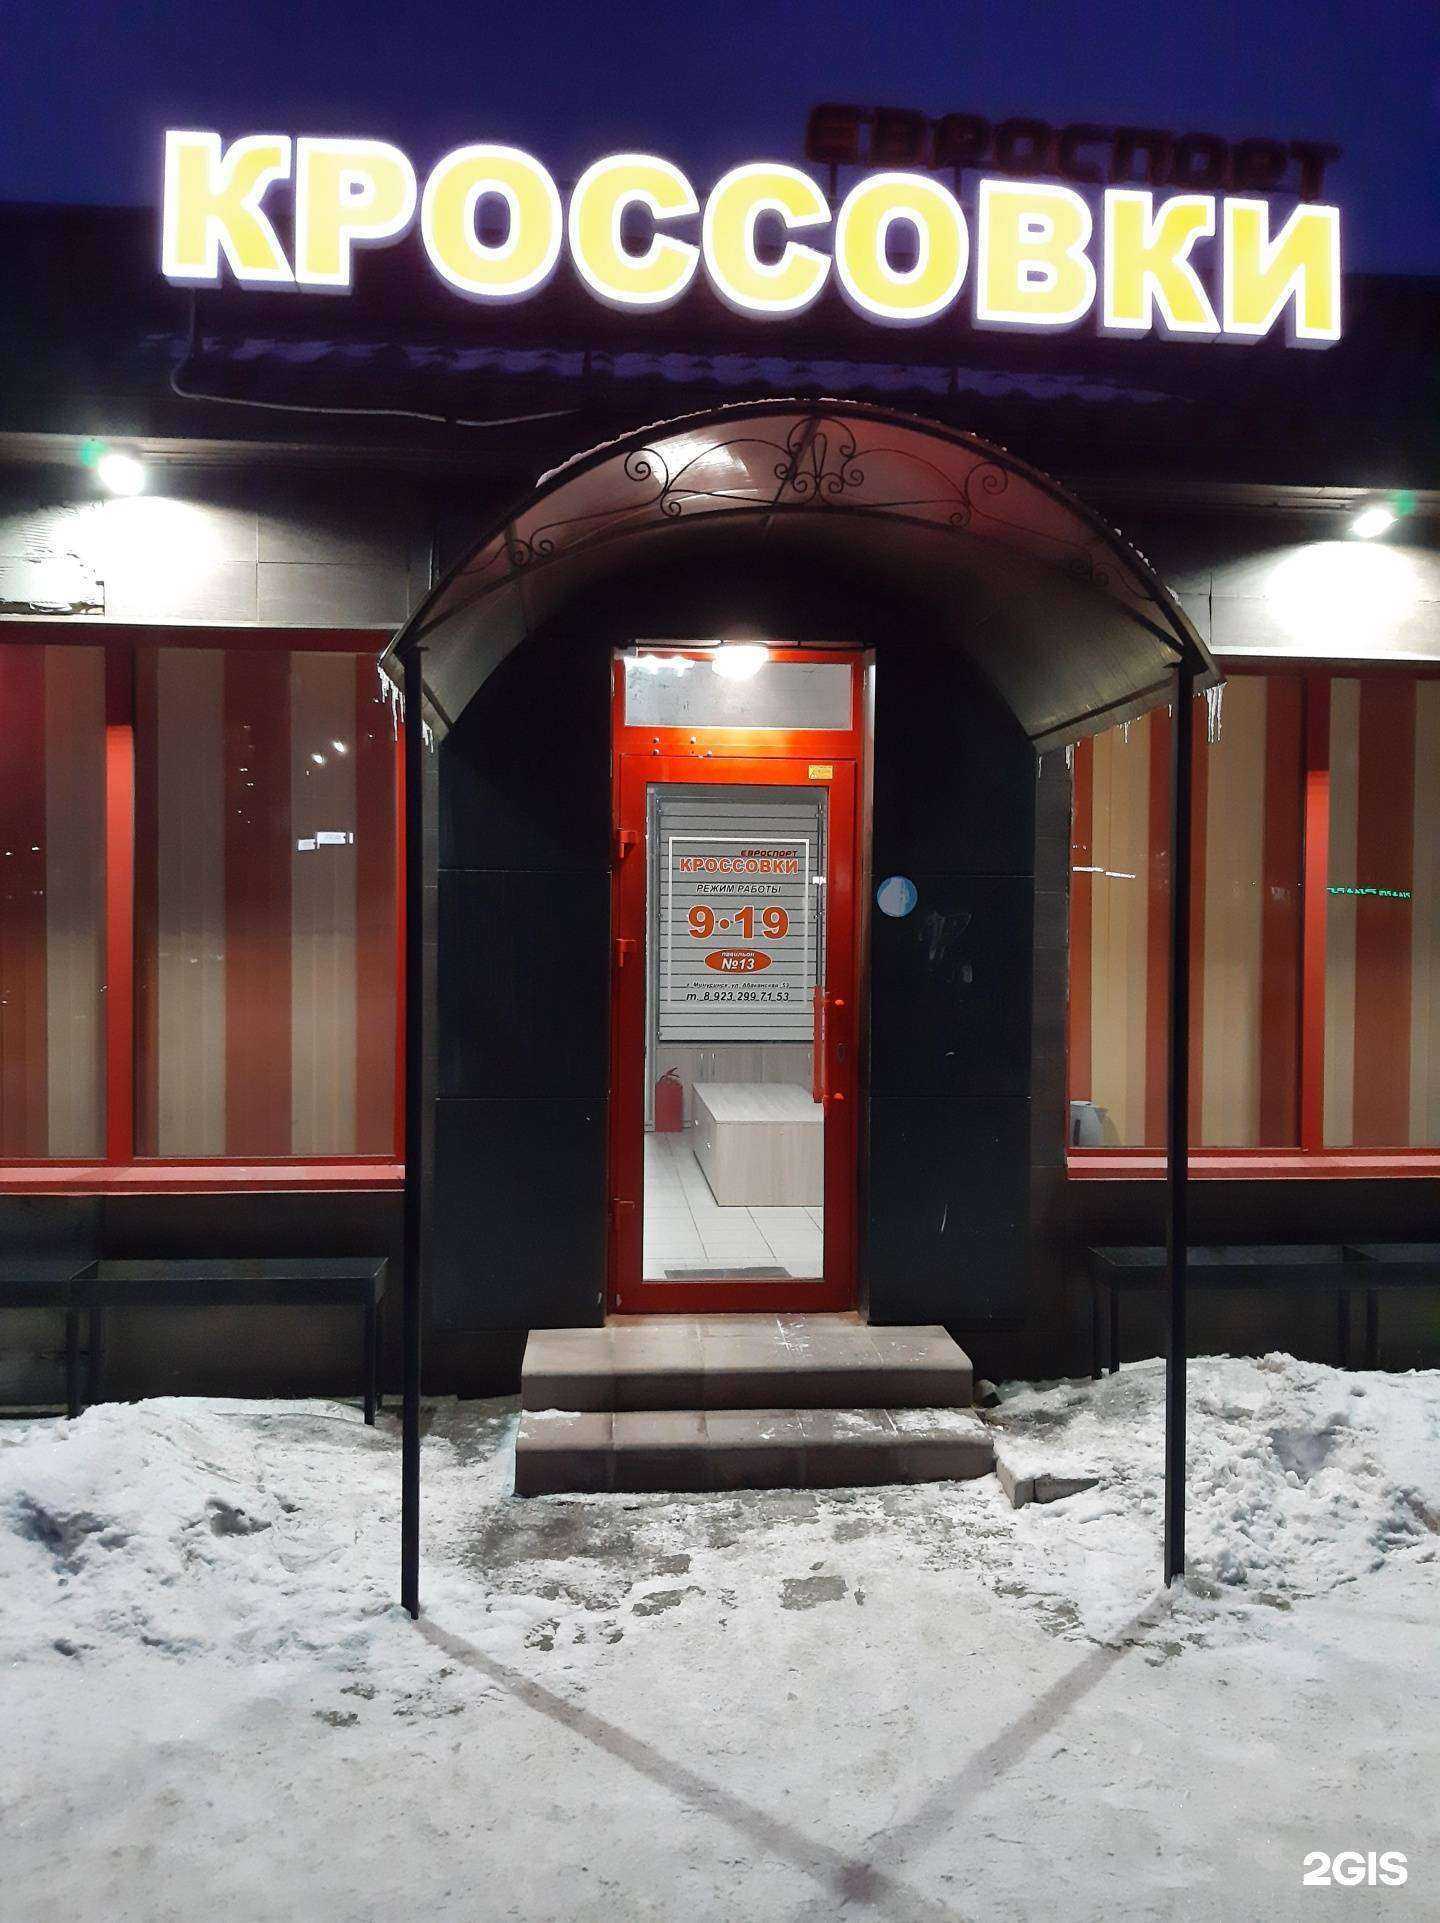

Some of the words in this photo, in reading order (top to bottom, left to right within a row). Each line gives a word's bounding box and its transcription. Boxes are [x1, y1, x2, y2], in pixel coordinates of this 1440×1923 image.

[160, 129, 1344, 349] КРОССОВКИ
[679, 858, 799, 874] КРОССОВКИ
[696, 884, 736, 893] РЕЖИМ
[737, 885, 782, 893] РАБОТЫ
[721, 957, 755, 970] №13
[703, 991, 711, 1001] 8
[714, 991, 733, 1001] 923
[737, 991, 756, 1001] 299
[760, 991, 772, 1001] 71
[776, 991, 790, 1001] 53
